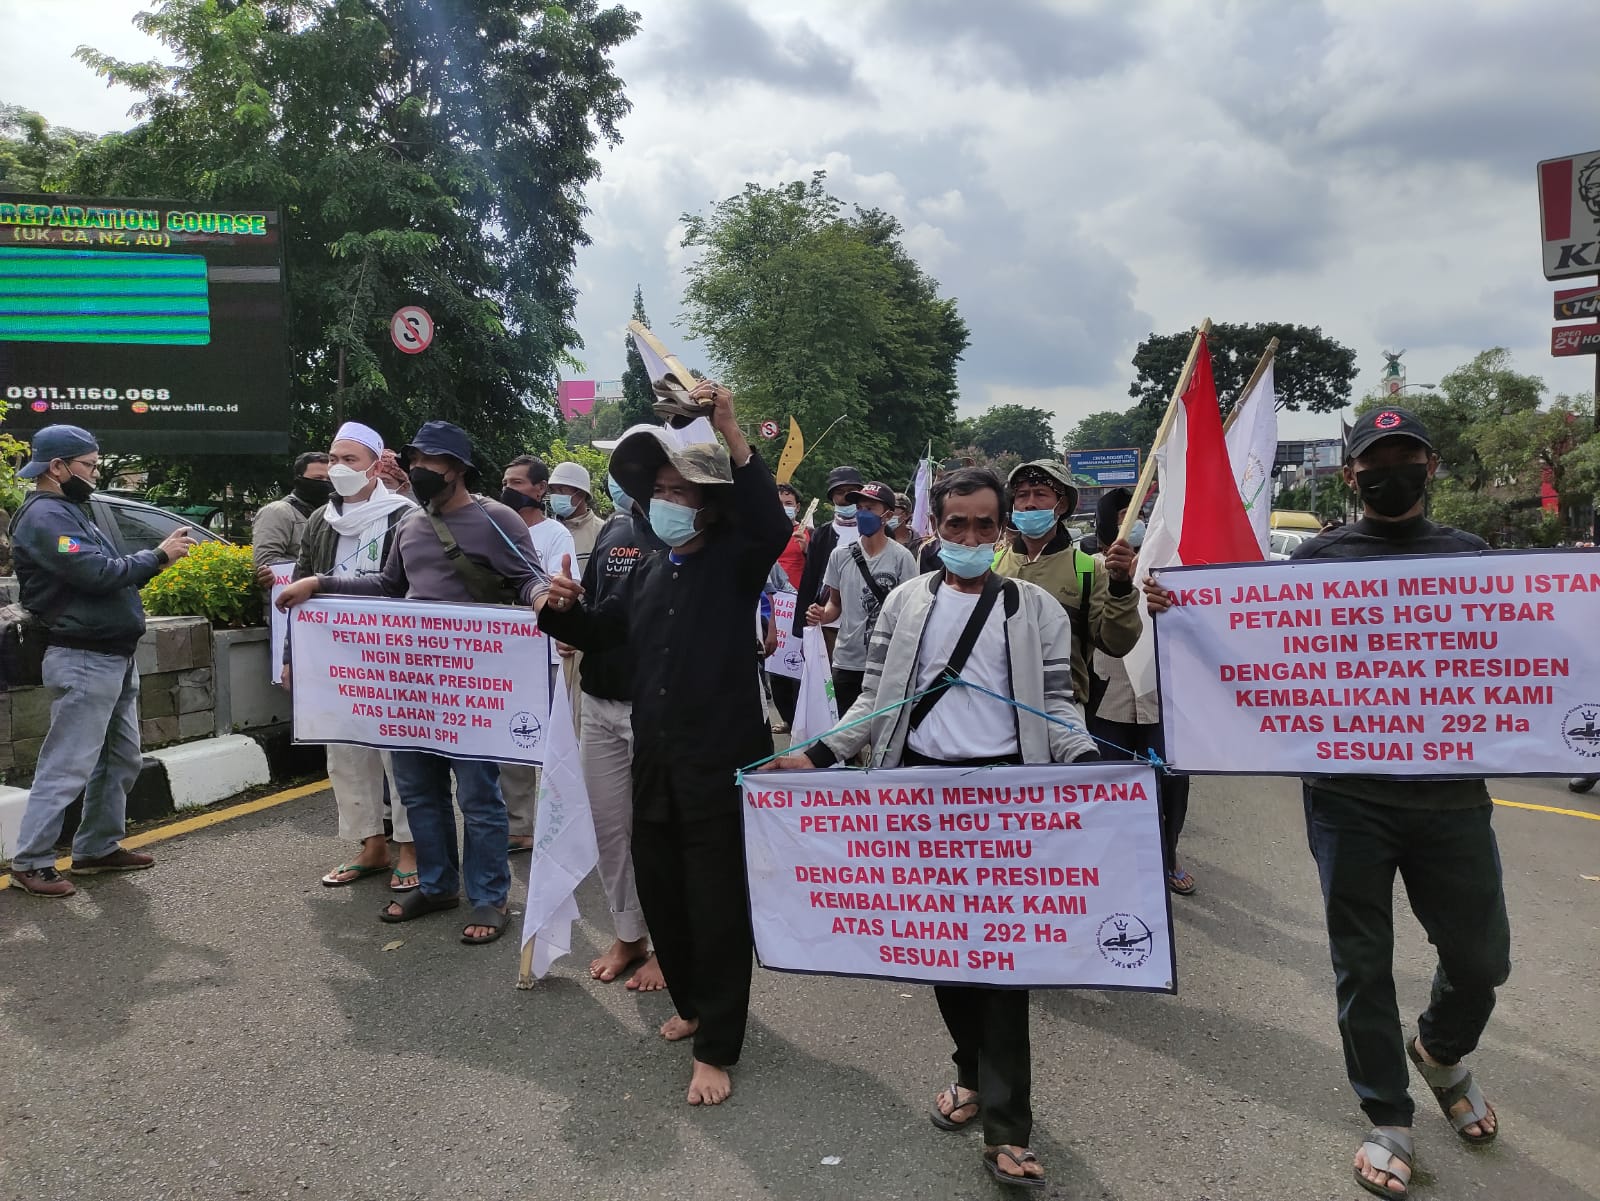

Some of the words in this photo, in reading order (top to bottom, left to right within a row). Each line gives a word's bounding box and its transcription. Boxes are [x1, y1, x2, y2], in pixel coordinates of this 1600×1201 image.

[0, 203, 160, 231] REPARATION
[167, 210, 267, 235] COURSE
[14, 227, 56, 243] (UK,
[61, 229, 94, 245] CA,
[99, 231, 131, 246] NZ,
[135, 233, 171, 248] AU)
[1554, 241, 1600, 270] K
[1573, 300, 1600, 315] 14
[1554, 336, 1580, 349] 24
[7, 386, 170, 401] 0811.1160.068
[51, 402, 119, 411] bill.course
[609, 547, 643, 559] CONF
[1166, 587, 1223, 607] AKSI
[1230, 582, 1314, 604] JALAN
[1322, 579, 1388, 599] KAKI
[1397, 575, 1515, 596] MENUJU
[297, 610, 329, 624] AKSI
[333, 612, 378, 626] JALAN
[381, 615, 417, 629] KAKI
[421, 617, 483, 633] MENUJU
[487, 621, 543, 638] ISTANA
[1229, 608, 1322, 631] PETANI
[1330, 606, 1384, 626] EKS
[1393, 604, 1452, 624] HGU
[1461, 601, 1555, 622] TYBAR
[332, 630, 381, 645] PETANI
[385, 633, 413, 647] EKS
[417, 636, 449, 649] HGU
[454, 637, 503, 653] TYBAR
[1283, 634, 1358, 654] INGIN
[1367, 631, 1498, 652] BERTEMU
[361, 650, 401, 664] INGIN
[405, 653, 474, 671] BERTEMU
[1219, 661, 1327, 682] DENGAN
[1335, 659, 1426, 680] BAPAK
[1435, 657, 1569, 678] PRESIDEN
[329, 665, 385, 681] DENGAN
[389, 670, 434, 685] BAPAK
[439, 674, 513, 693] PRESIDEN
[338, 684, 428, 702] KEMBALIKAN
[431, 693, 462, 706] HAK
[465, 695, 505, 710] KAMI
[1235, 687, 1410, 708] KEMBALIKAN
[1419, 686, 1476, 706] HAK
[1484, 685, 1553, 705] KAMI
[351, 703, 383, 717] ATAS
[387, 707, 435, 721] LAHAN
[443, 712, 466, 727] 292
[471, 715, 492, 728] Ha
[1259, 714, 1325, 733] ATAS
[1332, 714, 1425, 734] LAHAN
[1442, 714, 1487, 733] 292
[1495, 713, 1530, 733] Ha
[379, 724, 430, 737] SESUAI
[435, 729, 459, 742] SPH
[1316, 741, 1414, 761] SESUAI
[1423, 741, 1474, 761] SPH
[747, 790, 793, 809] AKSI
[800, 789, 872, 808] JALAN
[877, 787, 935, 806] KAKI
[942, 786, 1045, 805] MENUJU
[1053, 782, 1147, 803] ISTANA
[799, 814, 879, 833] PETANI
[885, 813, 932, 832] EKS
[939, 813, 990, 832] HGU
[997, 811, 1082, 831] TYBAR
[847, 839, 911, 859] INGIN
[918, 839, 1033, 859] BERTEMU
[794, 865, 886, 885] DENGAN
[891, 866, 968, 886] BAPAK
[976, 867, 1100, 887] PRESIDEN
[809, 891, 956, 913] KEMBALIKAN
[963, 895, 1014, 914] HAK
[1022, 895, 1087, 915] KAMI
[831, 916, 885, 937] ATAS
[891, 919, 969, 941] LAHAN
[983, 922, 1026, 943] 292
[1034, 923, 1068, 943] Ha
[879, 944, 959, 968] SESUAI
[967, 949, 1015, 971] SPH
